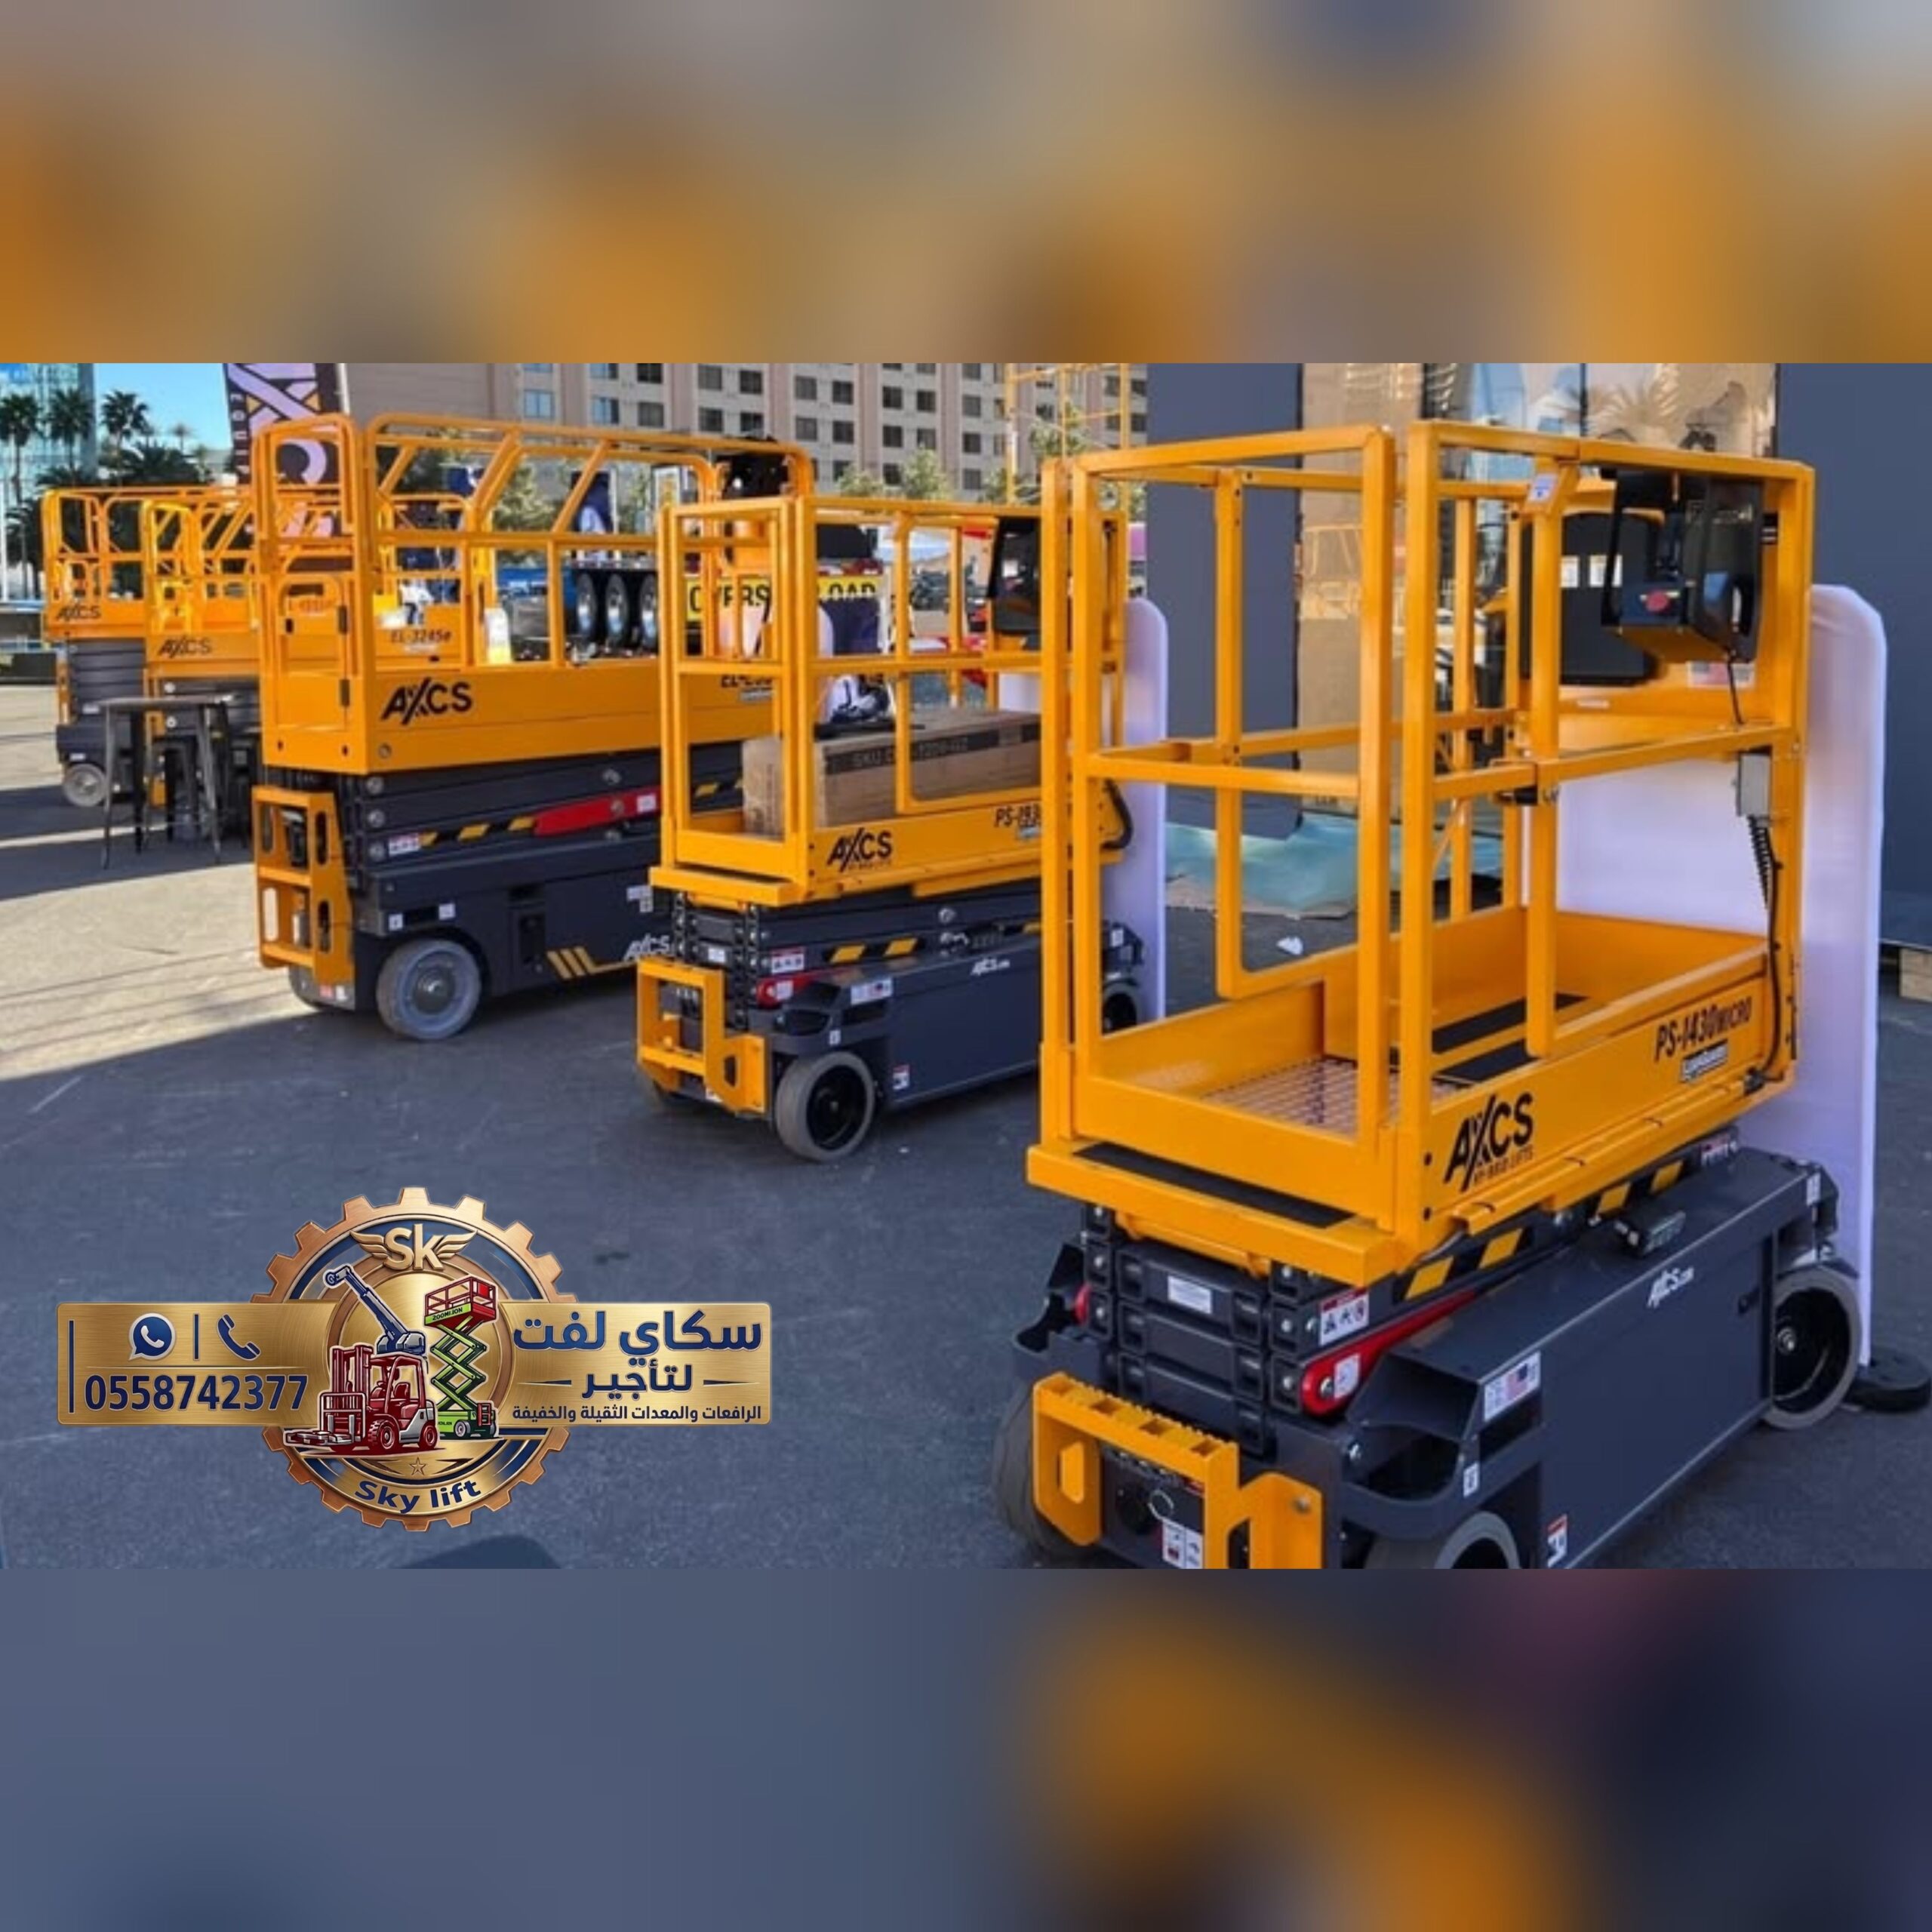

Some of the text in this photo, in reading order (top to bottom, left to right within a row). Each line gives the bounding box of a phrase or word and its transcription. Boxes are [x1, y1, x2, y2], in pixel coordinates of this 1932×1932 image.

[380, 676, 472, 726] AXCS
[826, 827, 893, 872] AXCS
[1443, 1091, 1534, 1192] AXCS
